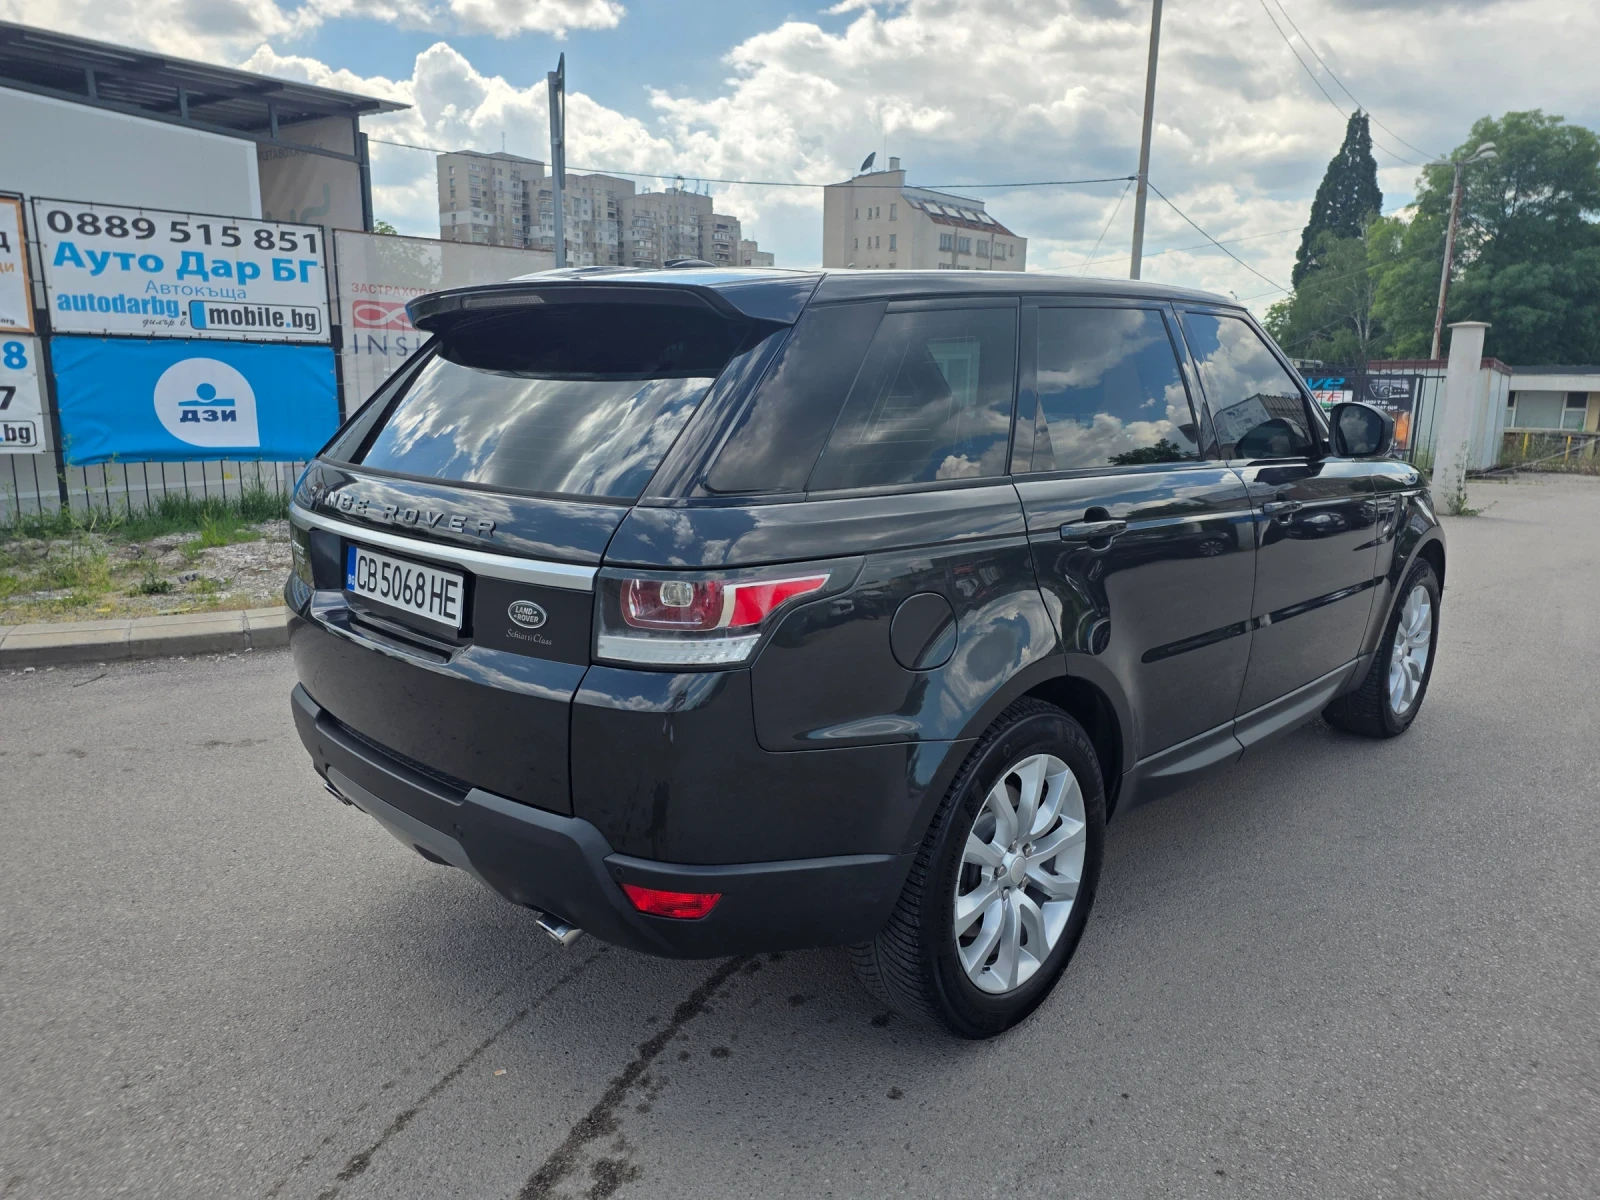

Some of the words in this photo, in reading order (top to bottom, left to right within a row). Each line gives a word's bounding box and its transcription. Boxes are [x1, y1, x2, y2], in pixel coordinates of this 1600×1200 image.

[47, 210, 156, 240] 0889
[169, 221, 242, 248] 515
[253, 229, 317, 254] 851
[53, 241, 164, 277] Ауто
[176, 251, 261, 286] Дар
[271, 258, 318, 283] БГ
[145, 280, 247, 301] Автокъща
[179, 409, 237, 423] ДЗИ
[383, 504, 497, 538] ROVER
[515, 605, 534, 616] LAND
[517, 613, 539, 623] ROVER
